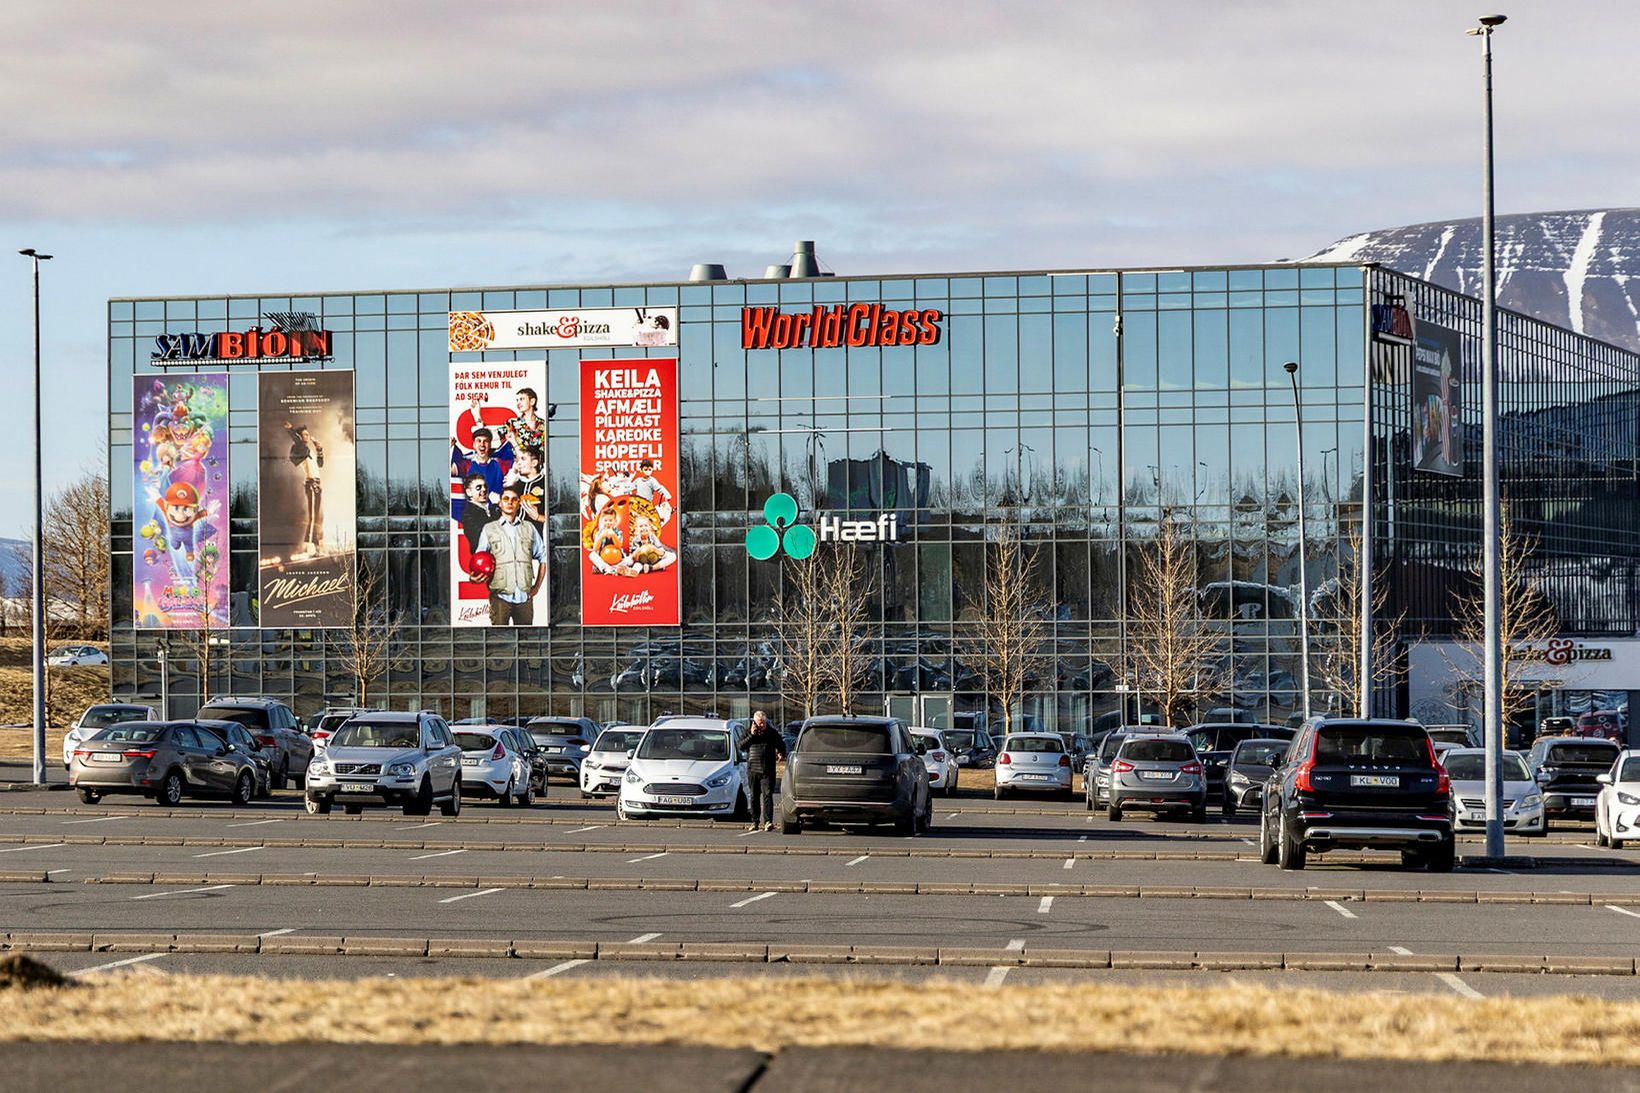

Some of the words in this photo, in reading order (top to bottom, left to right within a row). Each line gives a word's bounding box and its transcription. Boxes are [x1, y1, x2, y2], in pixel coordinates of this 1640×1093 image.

[517, 316, 611, 339] shake&pizza
[471, 371, 486, 380] SEM
[488, 370, 528, 379] VENJULEGT
[594, 368, 662, 389] KEILA
[475, 381, 499, 390] KEMUR
[501, 381, 512, 389] TIL
[594, 388, 662, 399] SHAKE&PIZZA
[594, 398, 662, 415] AFMÆLI
[595, 413, 661, 428] PÍLUKAST
[595, 428, 662, 442] KAREOKE
[594, 440, 663, 459] HÓPEFLI
[820, 513, 897, 542] Hæfi
[264, 572, 349, 605] Michael
[1500, 639, 1613, 667] hake&pizza
